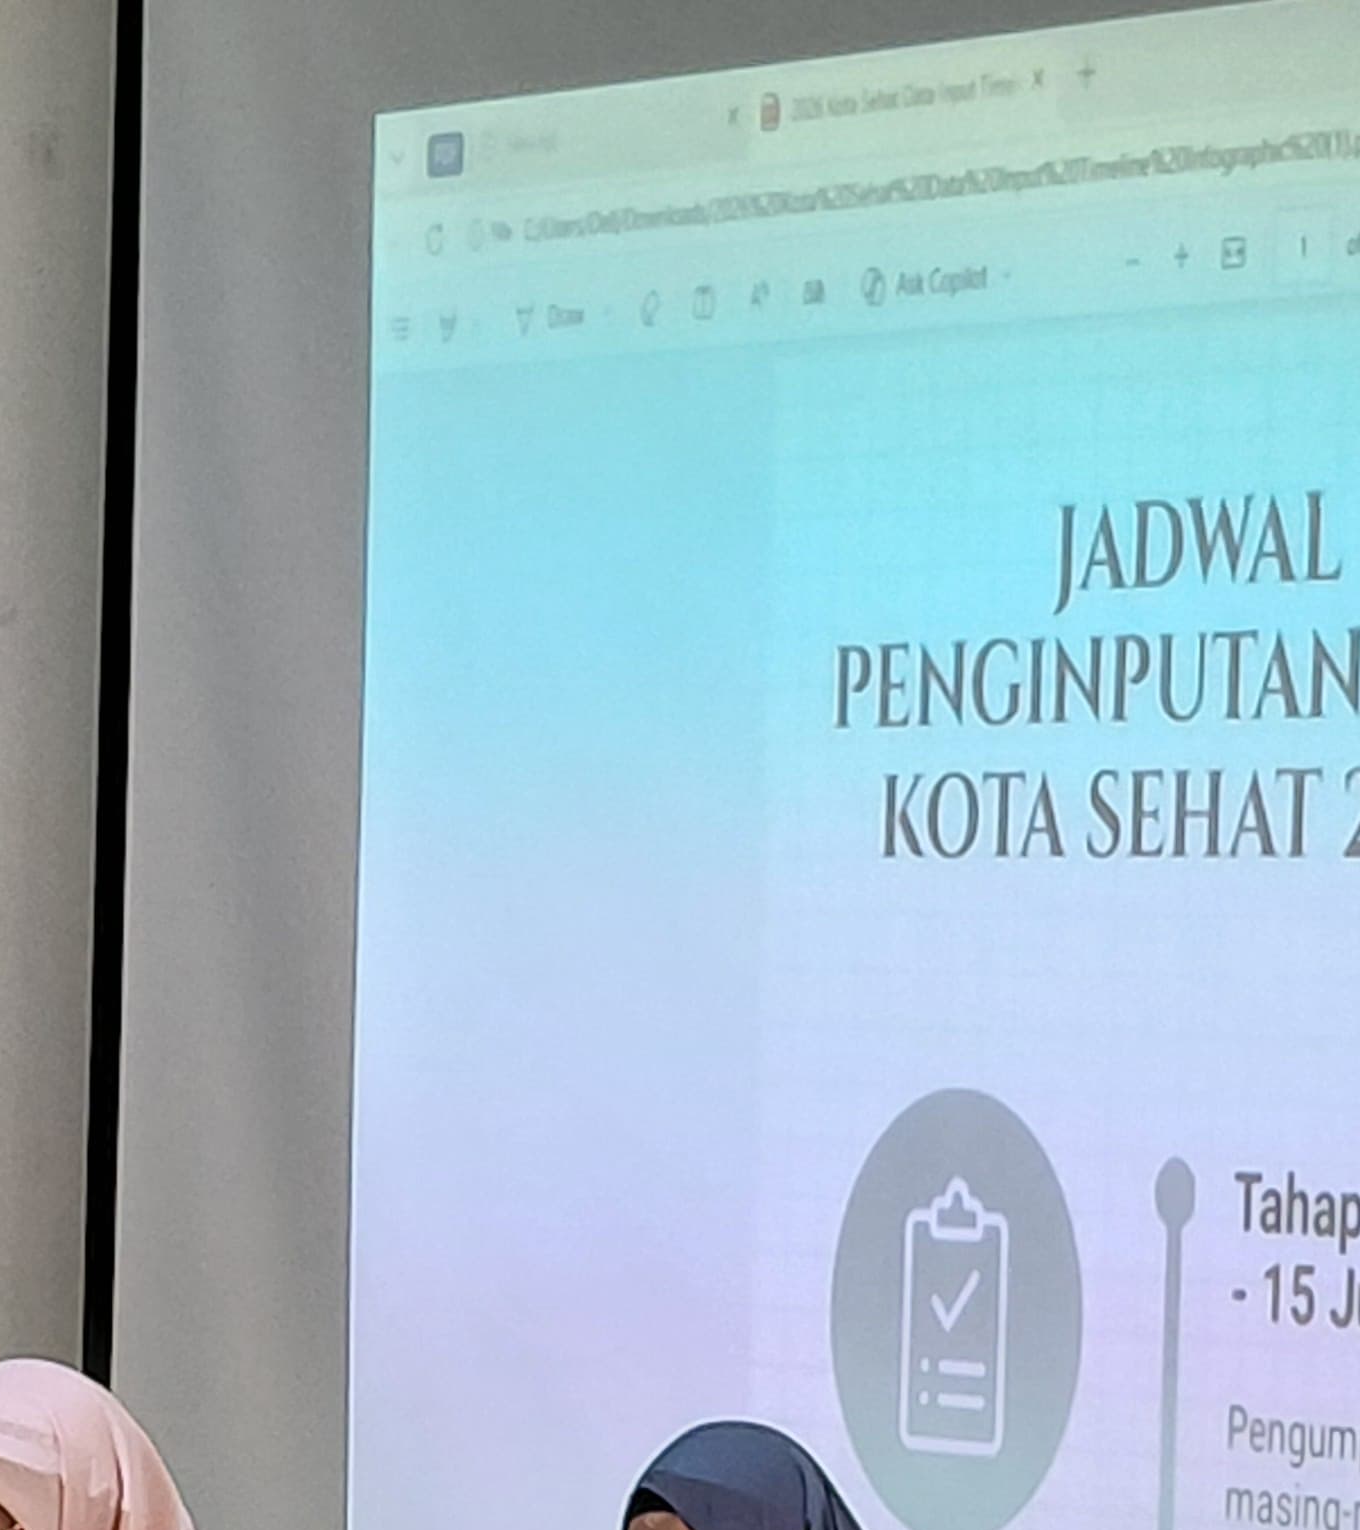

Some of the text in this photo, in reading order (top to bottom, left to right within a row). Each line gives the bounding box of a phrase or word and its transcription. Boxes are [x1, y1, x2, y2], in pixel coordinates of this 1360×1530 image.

[896, 265, 987, 298] Ask Copilot
[1052, 490, 1343, 616] JADWAL
[881, 771, 1065, 859] KOTA
[1085, 767, 1323, 859] SEHAT
[1264, 1263, 1316, 1326] 15
